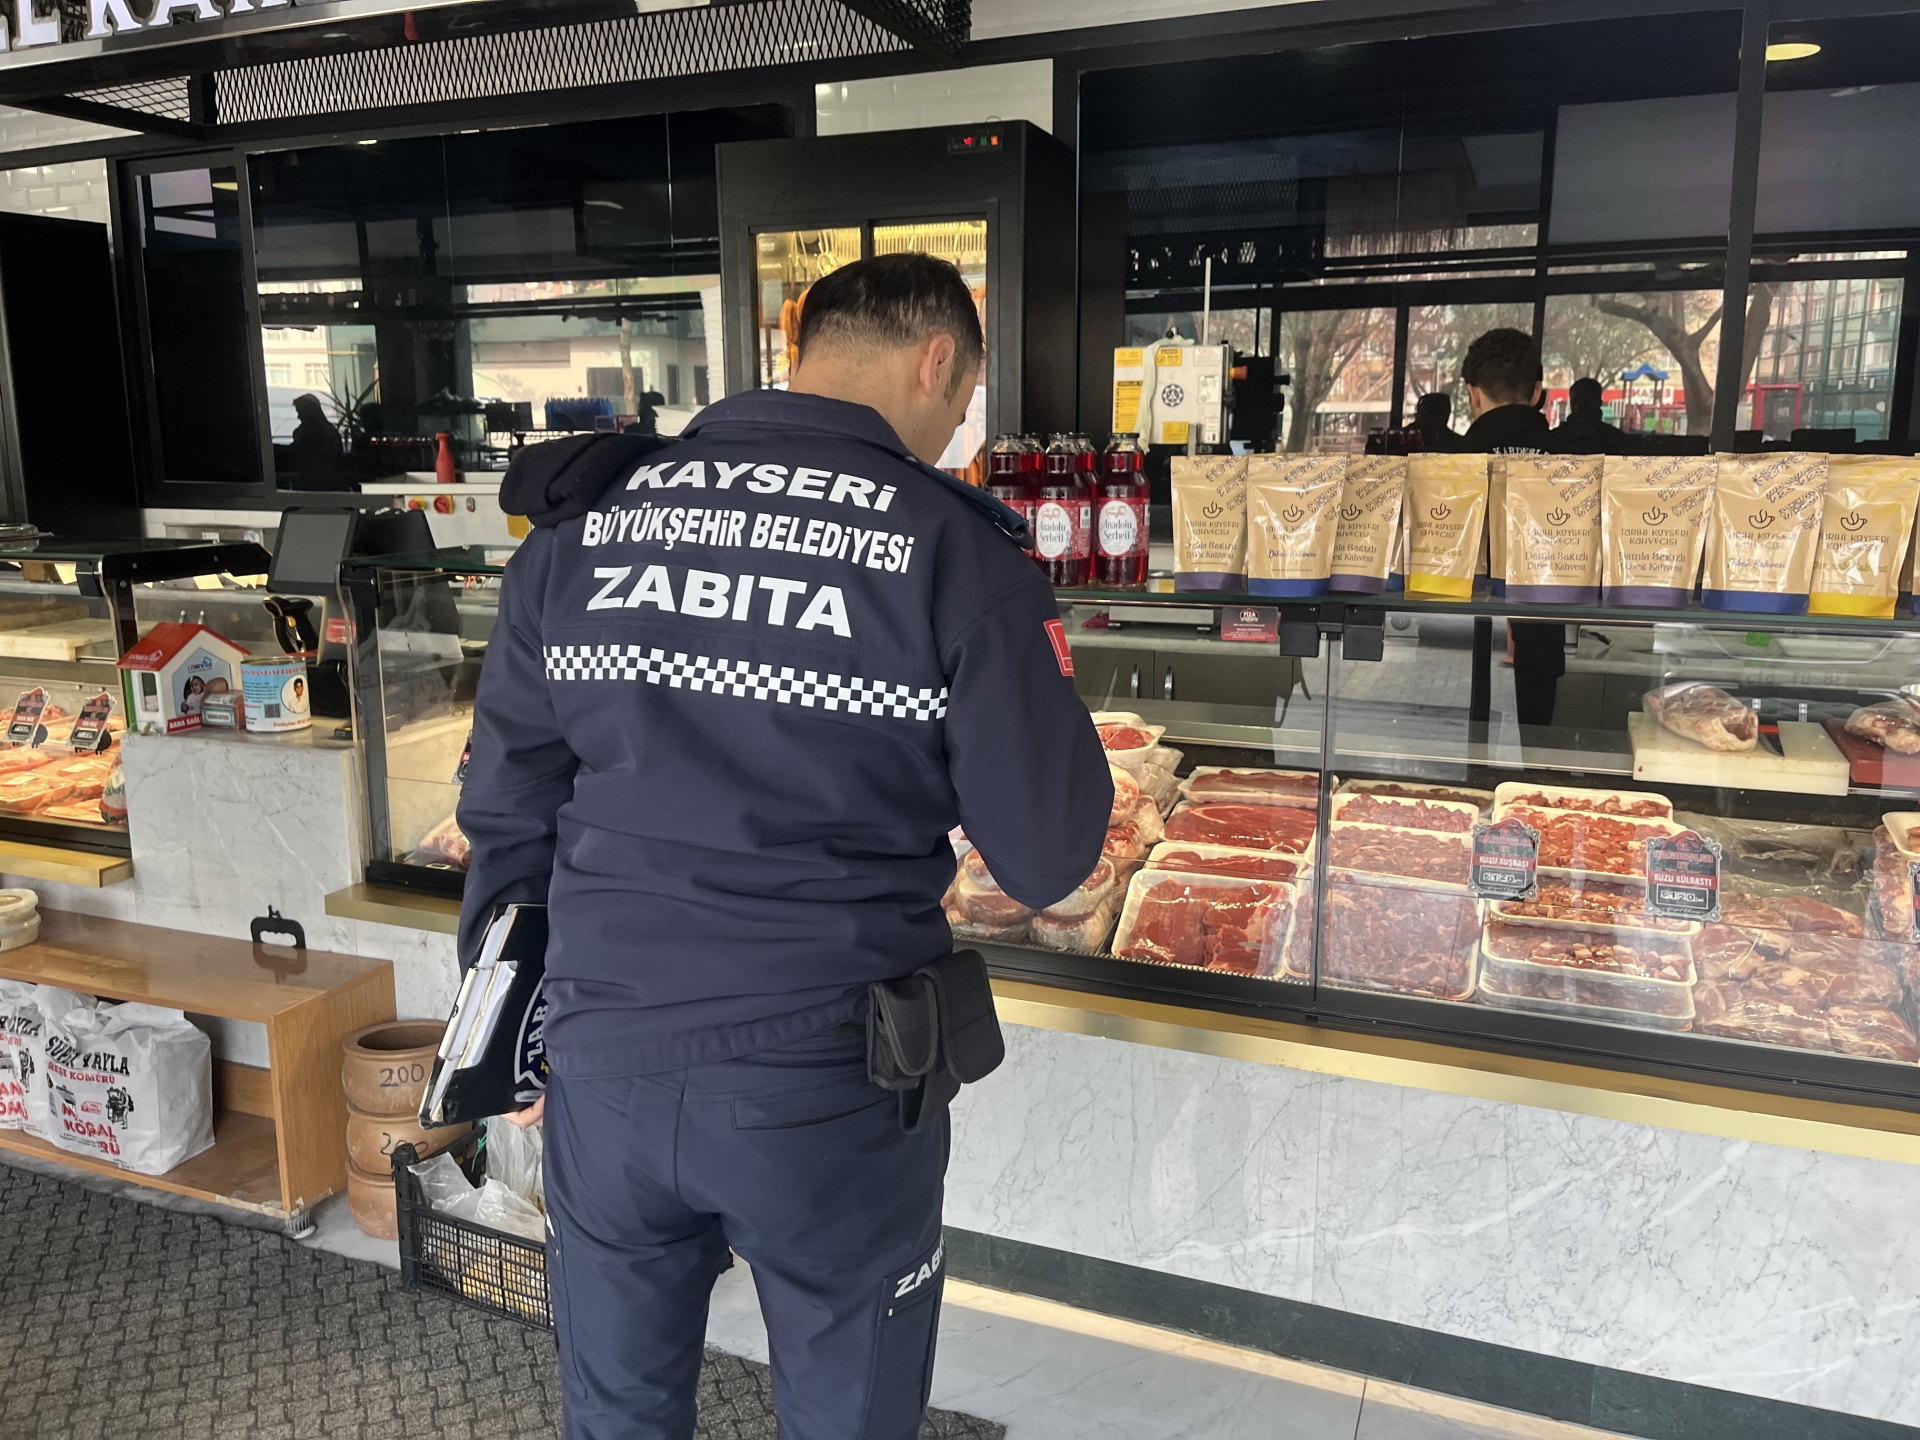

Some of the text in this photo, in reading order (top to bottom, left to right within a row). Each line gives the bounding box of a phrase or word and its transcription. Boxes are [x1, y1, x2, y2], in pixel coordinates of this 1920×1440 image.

[1037, 520, 1065, 532] Anadolu
[1100, 518, 1132, 531] Anadolu
[586, 564, 852, 637] ZABITA
[1479, 856, 1529, 869] KUZU KUŞBAŞI
[1653, 873, 1712, 887] KUZU KÜLBASTI
[380, 1063, 425, 1088] 200
